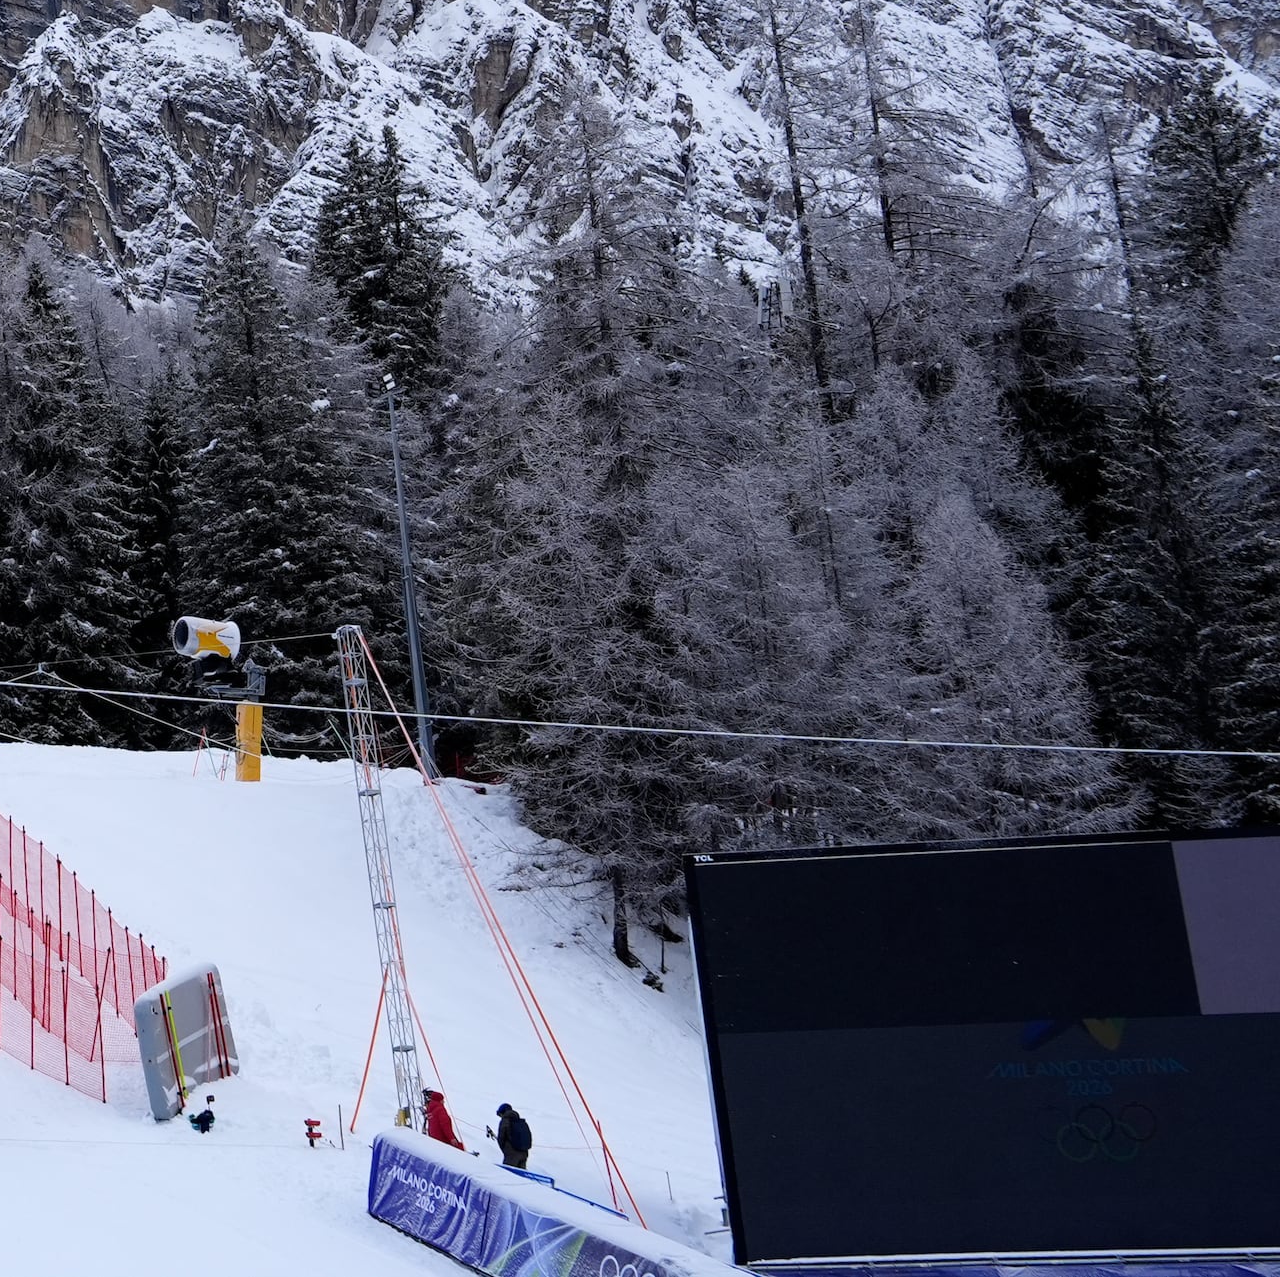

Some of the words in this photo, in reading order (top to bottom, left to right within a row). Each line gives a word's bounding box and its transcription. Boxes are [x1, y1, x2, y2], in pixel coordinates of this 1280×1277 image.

[988, 1060, 1083, 1079] MILANO
[1088, 1058, 1189, 1076] CORTINA
[1065, 1079, 1113, 1096] 2026
[388, 1165, 428, 1192] MILANO
[428, 1182, 467, 1212] CORTINA
[415, 1193, 436, 1214] 2026
